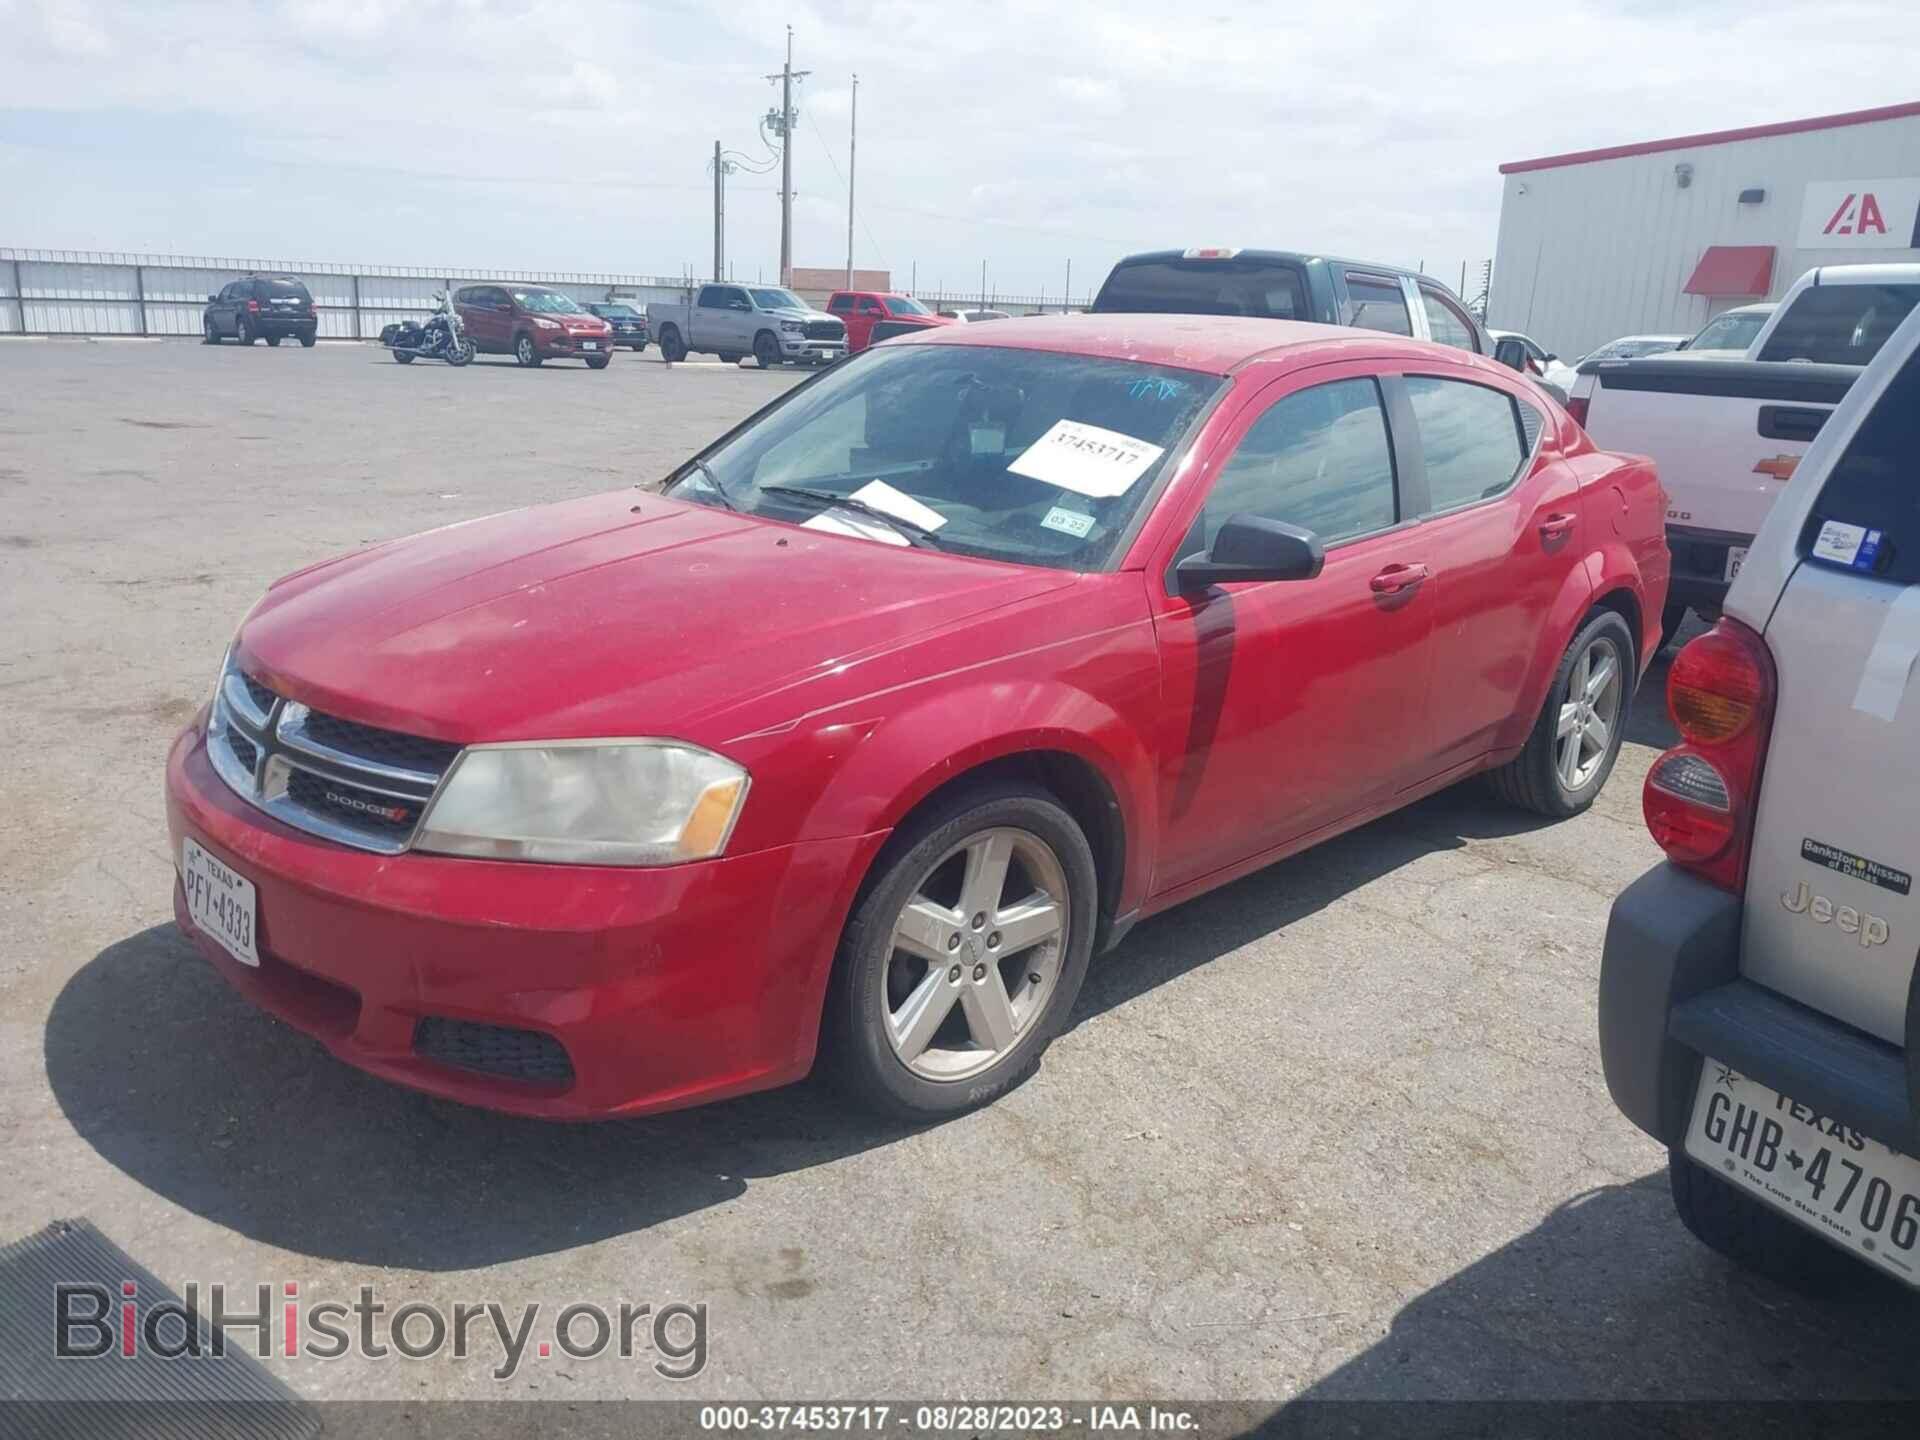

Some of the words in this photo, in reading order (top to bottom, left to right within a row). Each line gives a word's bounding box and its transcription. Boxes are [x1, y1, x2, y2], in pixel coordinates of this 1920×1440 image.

[326, 791, 394, 817] DODGE
[206, 858, 234, 890] TEXAS
[219, 891, 250, 949] 4333
[1782, 880, 1889, 949] Jeep
[1704, 1092, 1784, 1173] GHB
[1804, 1147, 1920, 1251] 4706
[1743, 1168, 1763, 1186] The
[1765, 1183, 1792, 1202] Lone
[1794, 1200, 1818, 1217] Star
[1821, 1213, 1852, 1237] State
